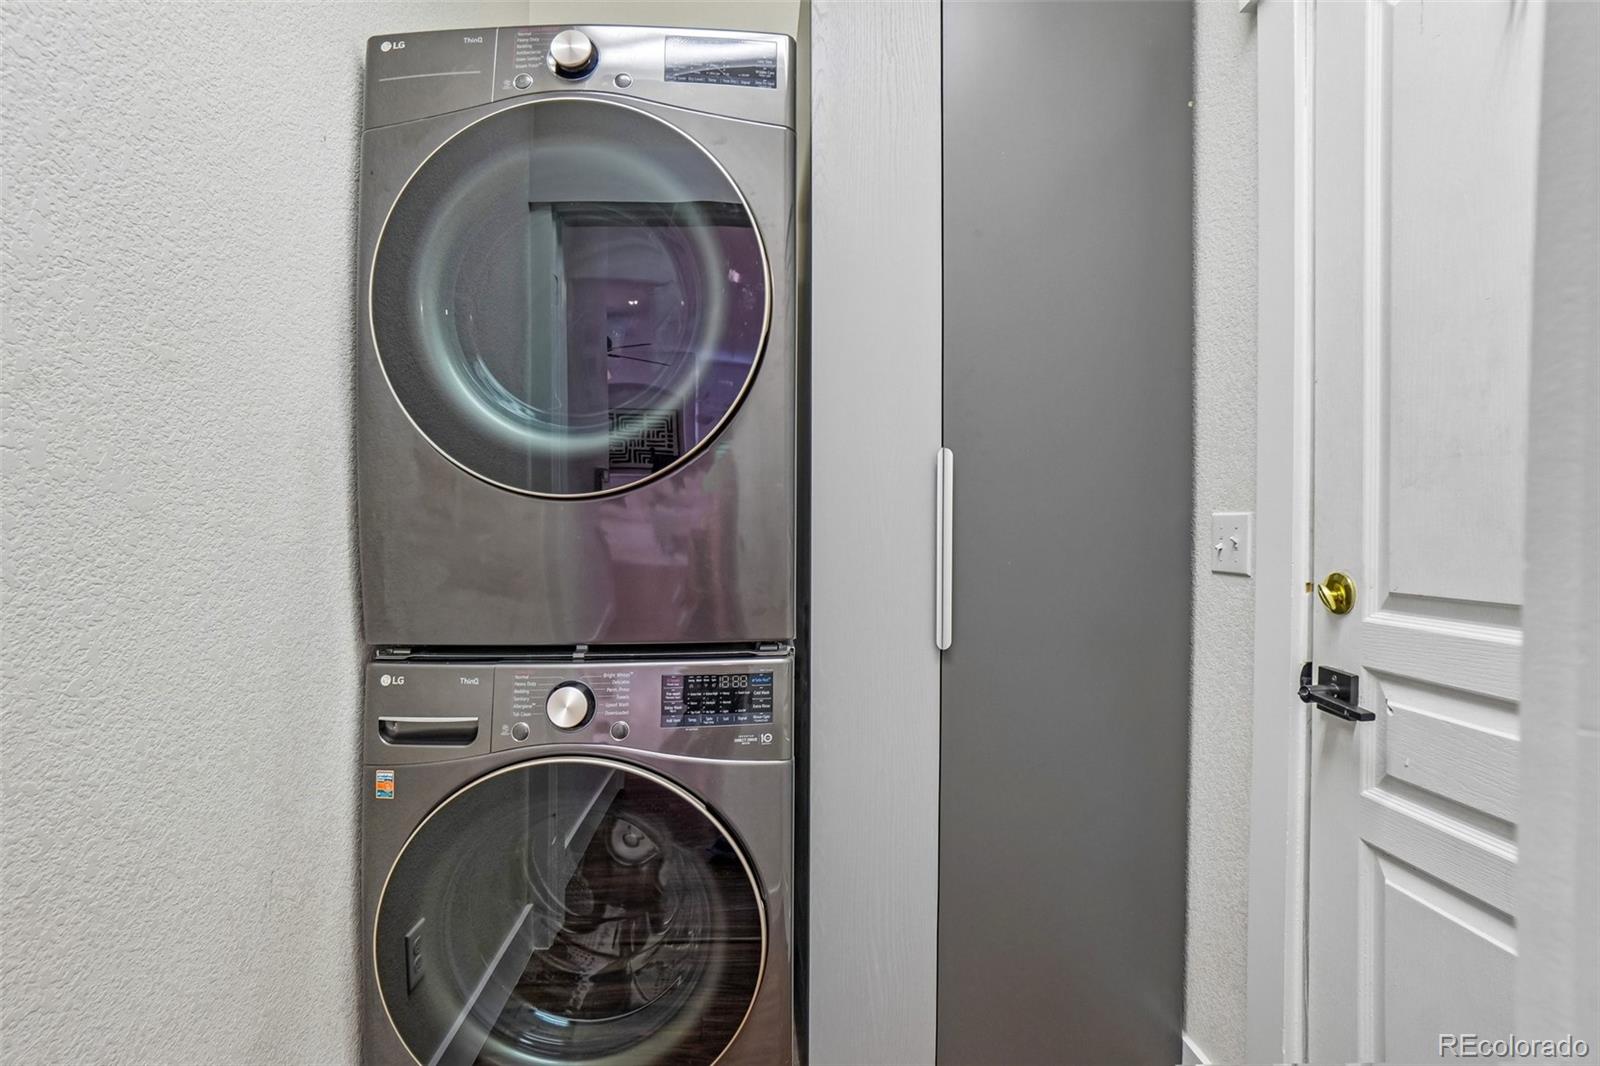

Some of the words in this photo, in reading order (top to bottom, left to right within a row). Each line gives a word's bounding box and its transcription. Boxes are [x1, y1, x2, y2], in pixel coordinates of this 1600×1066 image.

[392, 40, 406, 50] LG
[392, 676, 404, 685] LG
[460, 677, 479, 685] ThinQ
